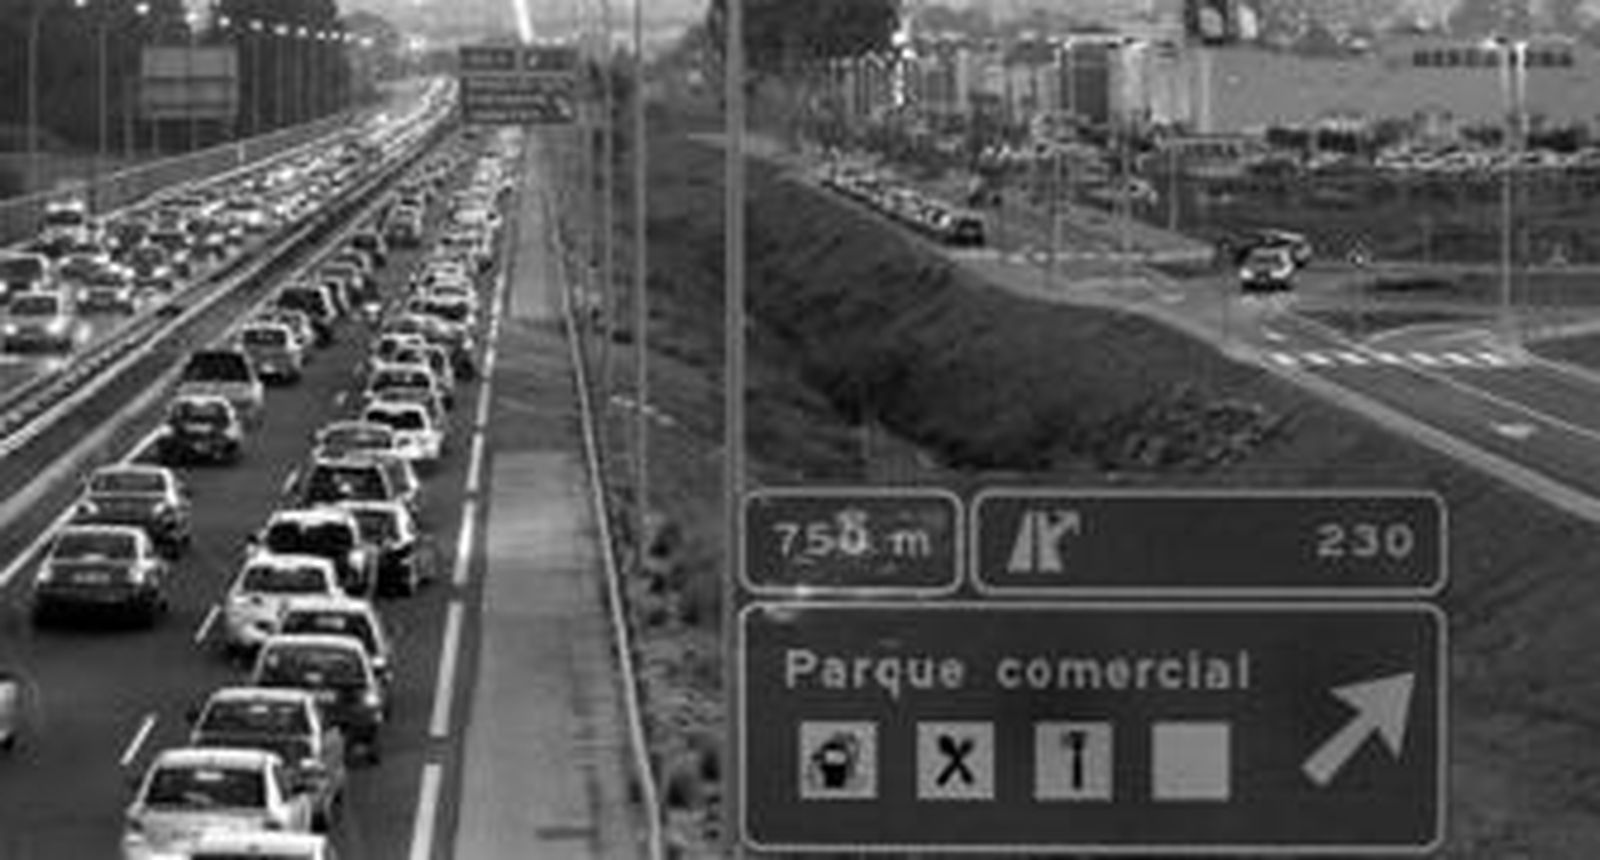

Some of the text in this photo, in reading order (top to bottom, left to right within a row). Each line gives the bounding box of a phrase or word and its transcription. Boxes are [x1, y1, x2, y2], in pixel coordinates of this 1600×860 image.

[775, 521, 934, 558] 750 m
[1317, 523, 1415, 557] 230
[785, 648, 1250, 699] Parque comercial
